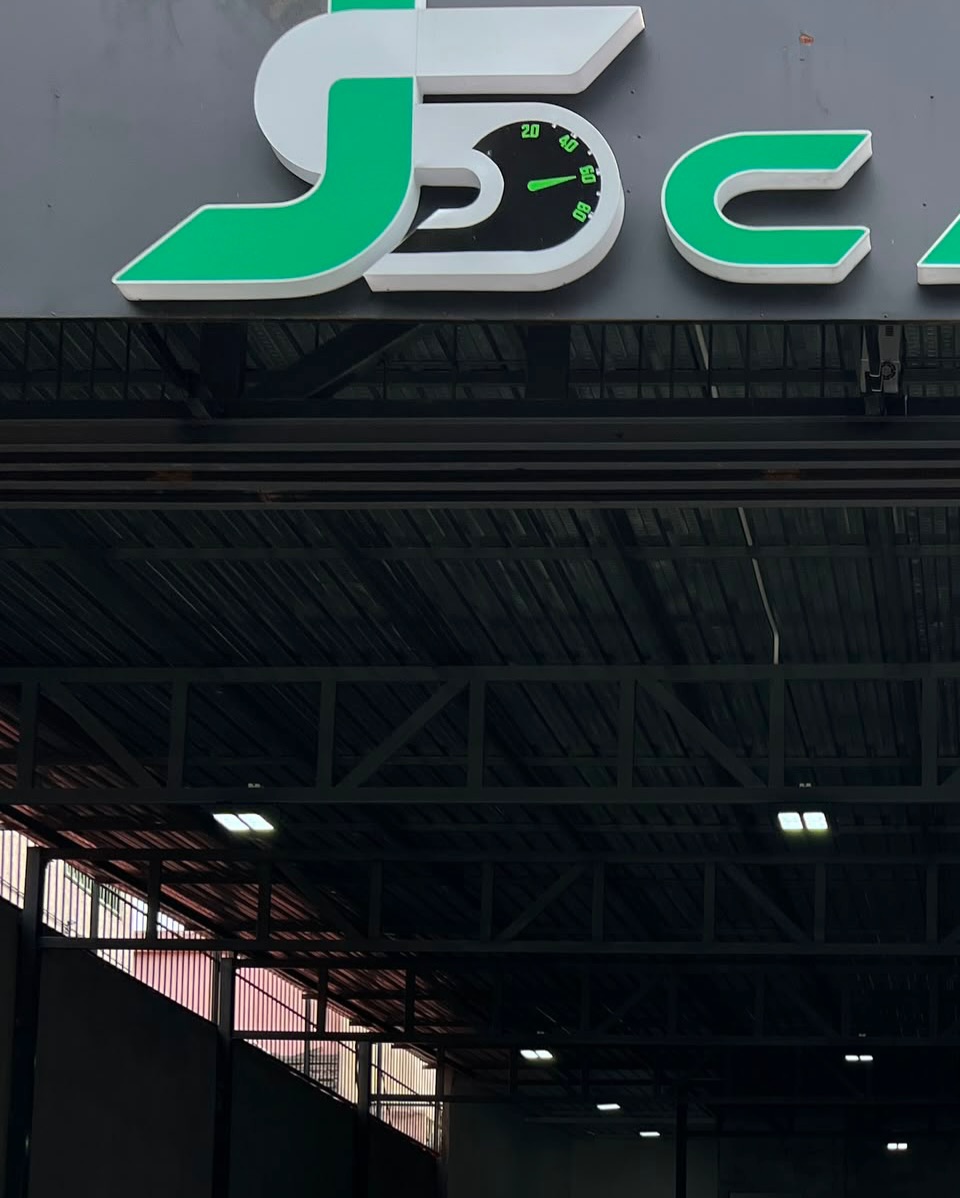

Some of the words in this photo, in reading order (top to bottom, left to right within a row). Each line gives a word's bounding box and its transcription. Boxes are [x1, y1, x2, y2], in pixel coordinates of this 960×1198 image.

[521, 124, 540, 139] 20
[559, 134, 579, 153] 40
[579, 165, 597, 184] 60
[572, 201, 592, 223] 80
